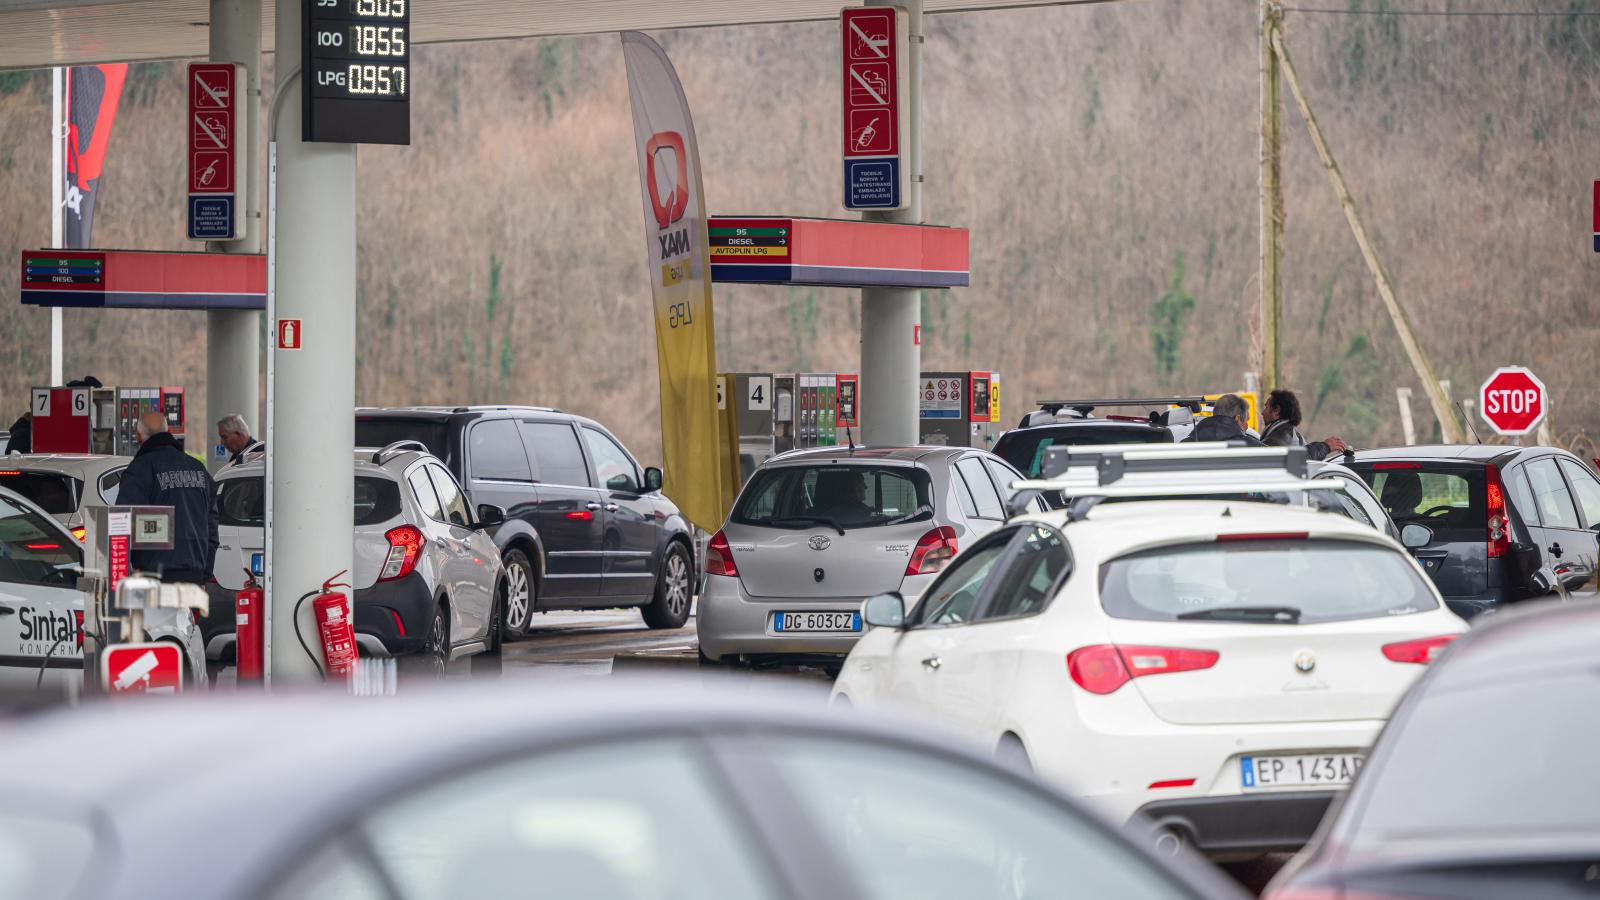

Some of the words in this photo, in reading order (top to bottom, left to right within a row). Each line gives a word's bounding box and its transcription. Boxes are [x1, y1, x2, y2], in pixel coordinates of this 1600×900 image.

[317, 31, 343, 47] 100
[317, 71, 346, 86] LPG
[736, 228, 748, 236] 95
[38, 394, 48, 411] 7
[74, 393, 85, 411] 6
[751, 384, 764, 404] 4
[1488, 389, 1538, 414] STOP
[19, 606, 74, 642] Sintal
[785, 614, 801, 629] DG
[807, 614, 852, 629] 603CZ
[20, 643, 74, 656] KONCERN
[1258, 759, 1284, 783] EP
